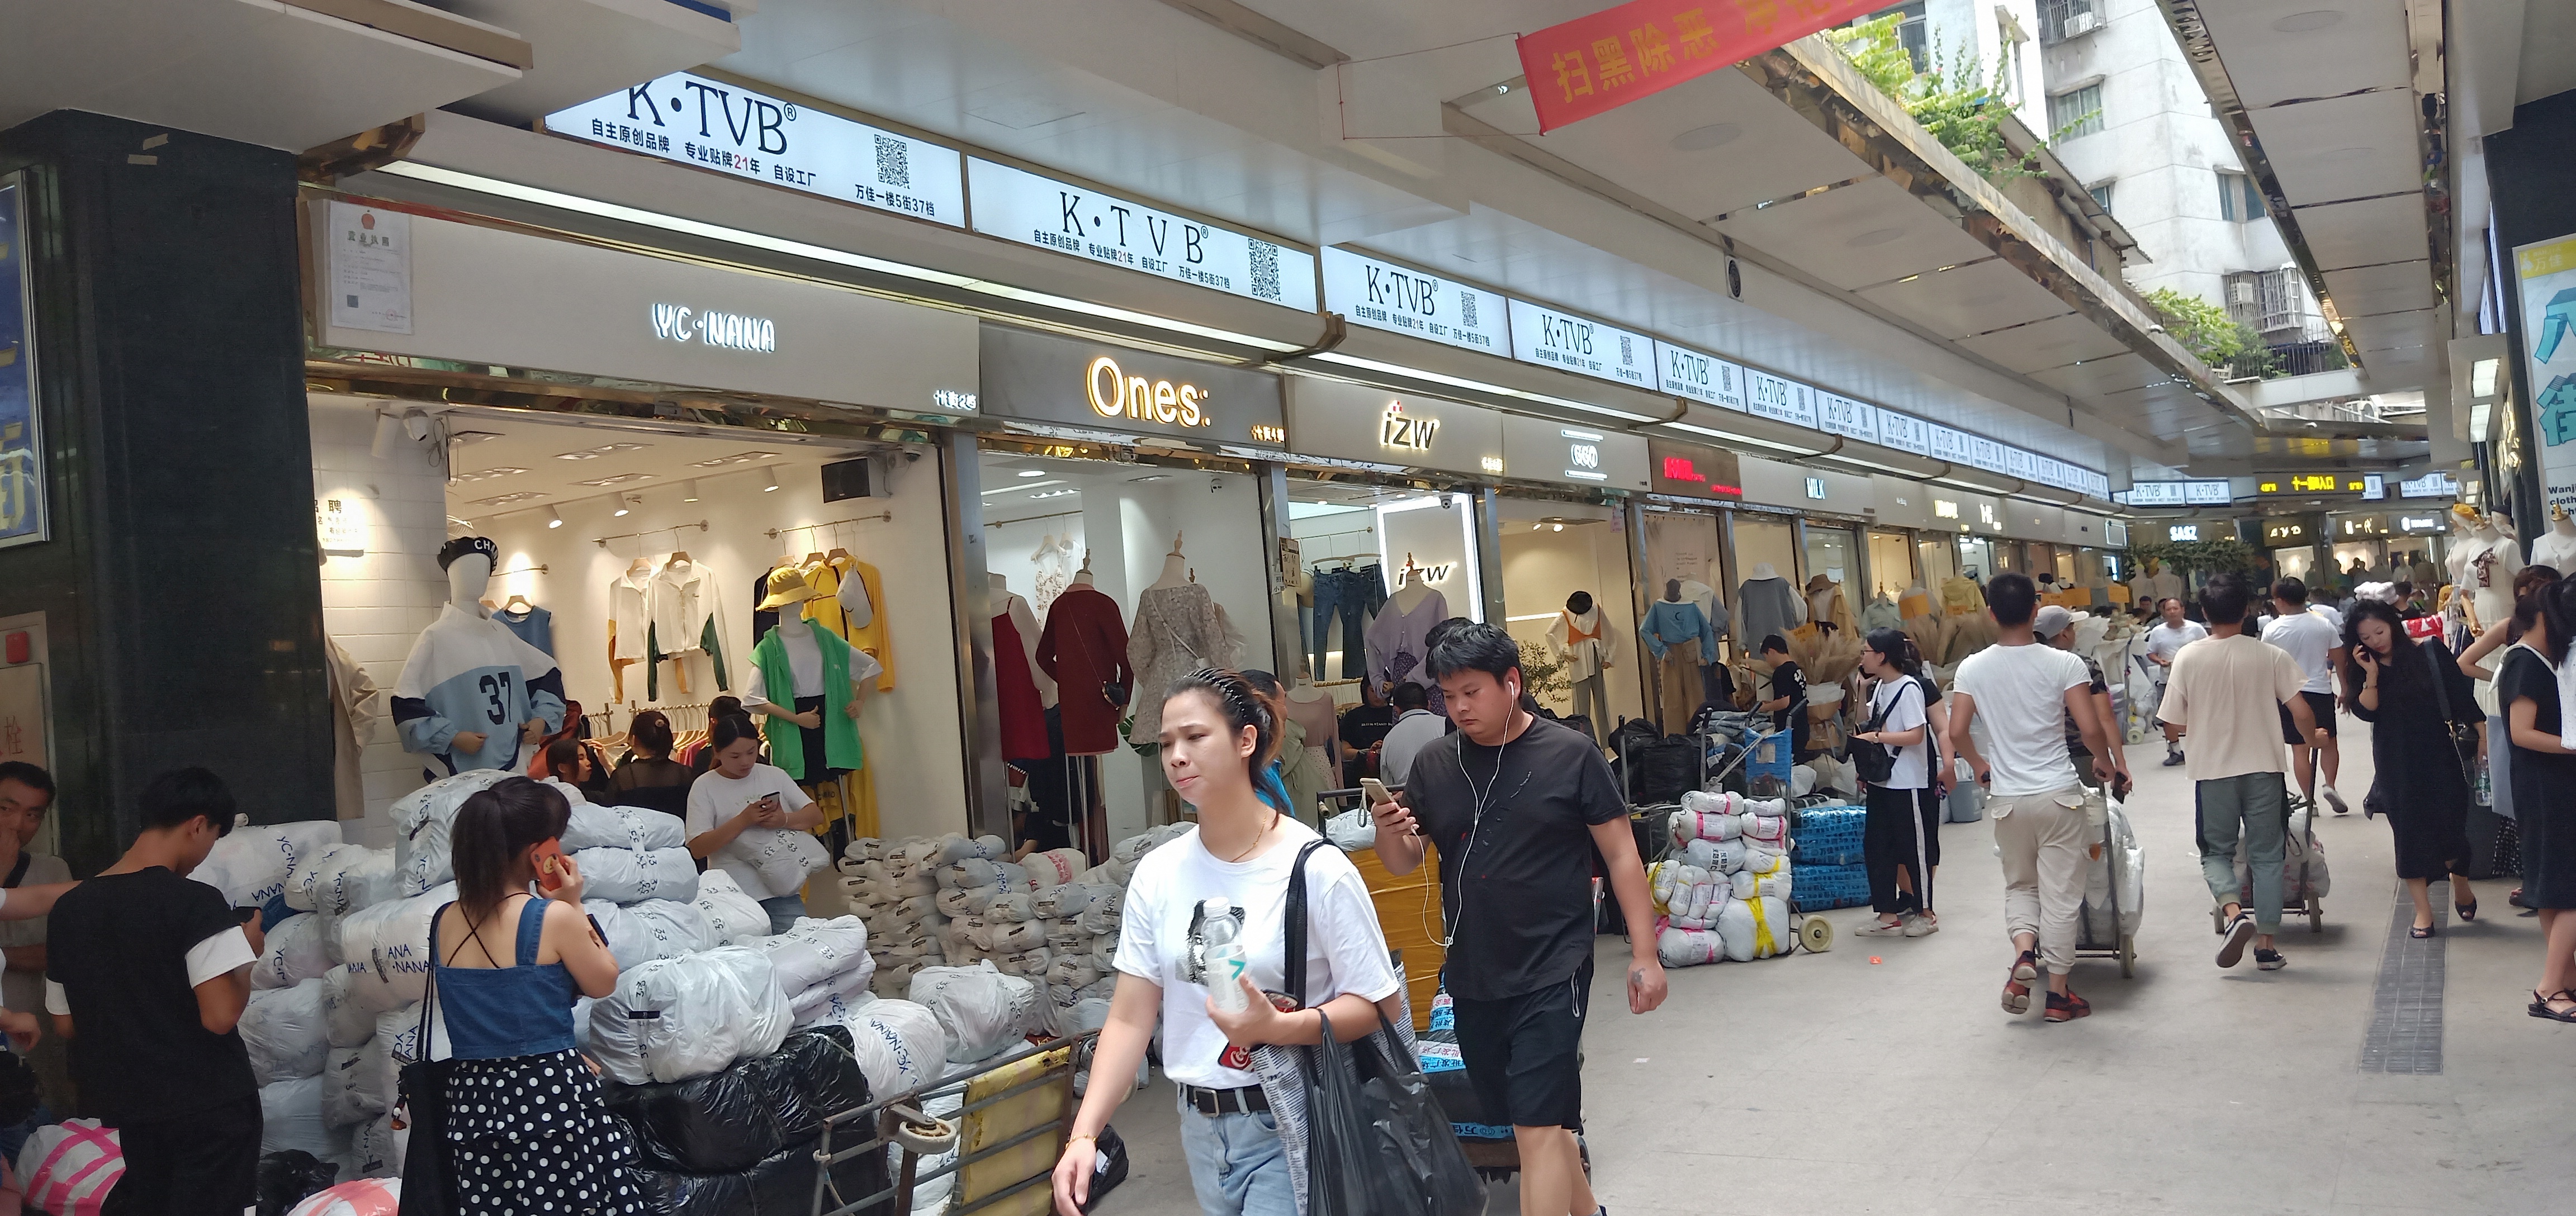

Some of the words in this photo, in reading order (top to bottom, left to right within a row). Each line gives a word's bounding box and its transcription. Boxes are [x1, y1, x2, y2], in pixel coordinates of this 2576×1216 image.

[1552, 7, 1720, 103] 扫黑除恶
[592, 118, 670, 153] 自主原创品牌
[685, 142, 761, 174] 专业贴牌21年
[774, 164, 817, 187] 自设工厂
[855, 184, 935, 217] 万佳一楼5街37档
[1034, 230, 1081, 252] 自主原创品牌
[1088, 243, 1134, 265] 专业贴牌21年
[1142, 256, 1168, 273] 自设工厂
[1805, 477, 1826, 500] MILK
[479, 671, 513, 726] 37
